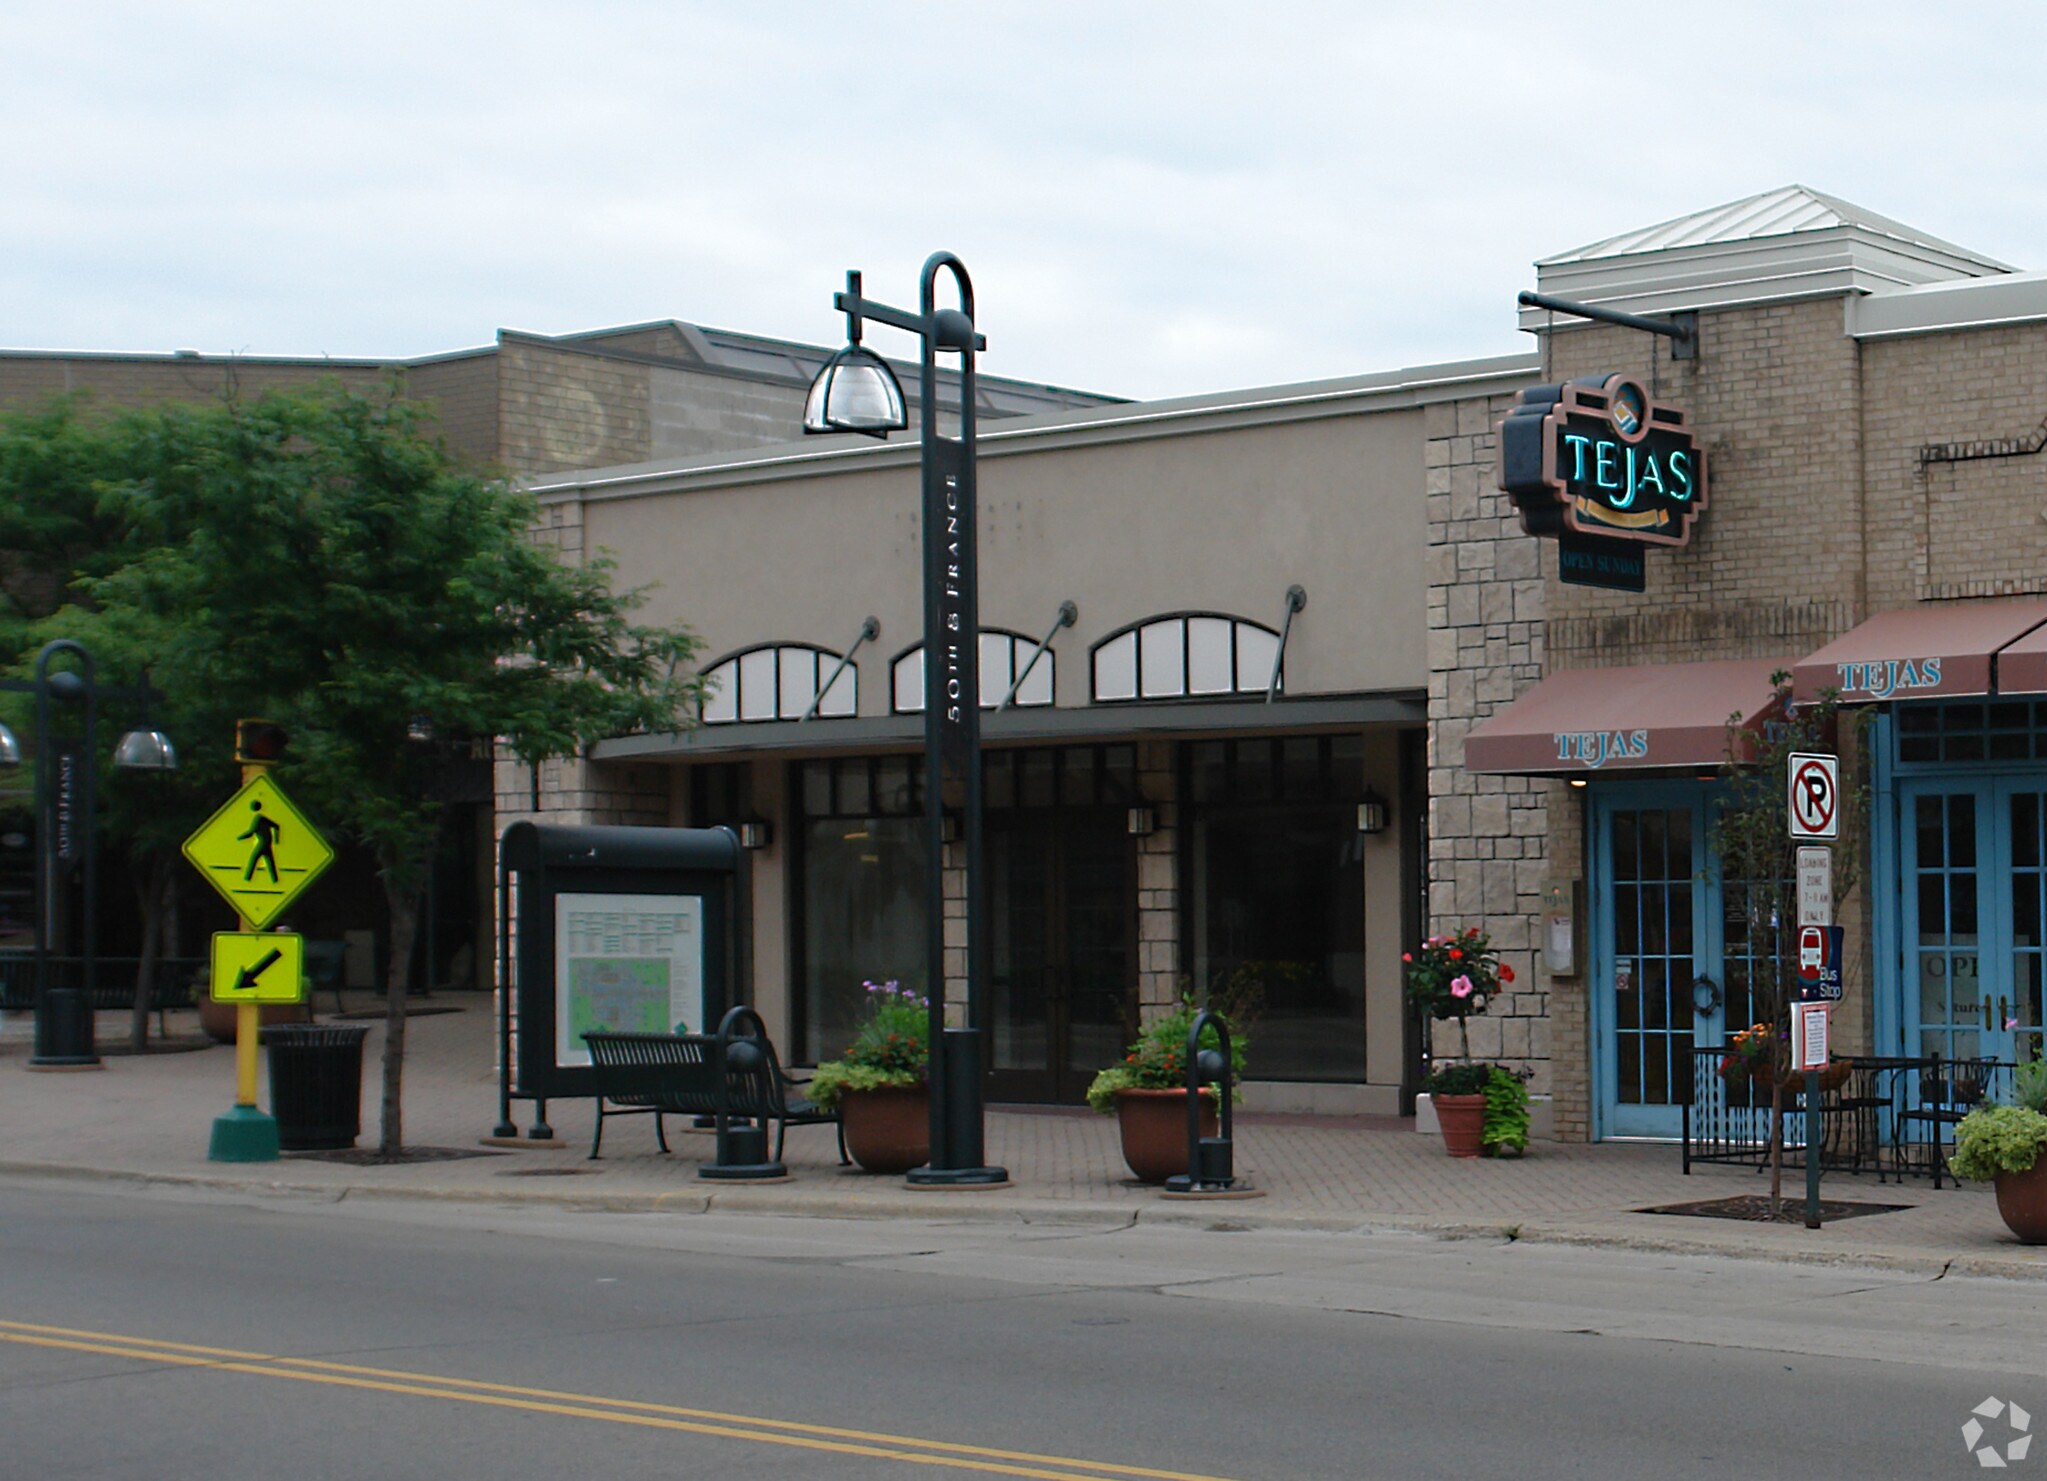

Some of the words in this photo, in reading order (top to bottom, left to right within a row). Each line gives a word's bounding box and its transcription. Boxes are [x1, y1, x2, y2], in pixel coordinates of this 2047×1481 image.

[1564, 434, 1692, 508] TEJAS
[945, 474, 960, 597] FRANCE
[1562, 550, 1594, 569] OPEN
[1597, 553, 1642, 577] SUNDAY
[1837, 657, 1942, 699] TEJAS
[1553, 728, 1648, 769] TEJAS
[1819, 966, 1838, 981] Bus
[1819, 983, 1841, 1000] Stop
